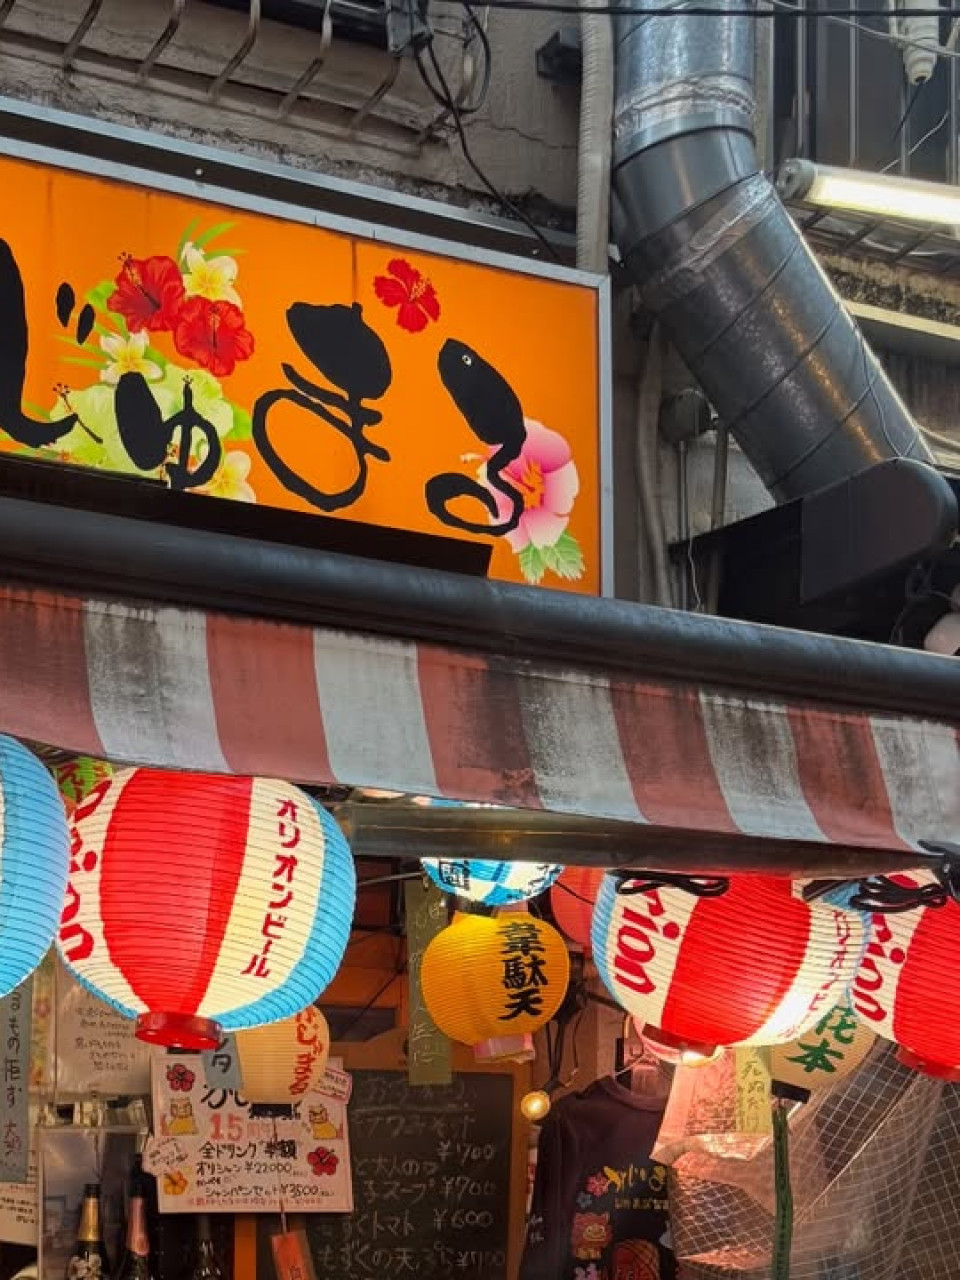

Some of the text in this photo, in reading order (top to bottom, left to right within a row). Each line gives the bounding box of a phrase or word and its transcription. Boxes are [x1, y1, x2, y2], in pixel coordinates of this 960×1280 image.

[241, 798, 301, 979] オリオンビール
[614, 880, 681, 995] rion
